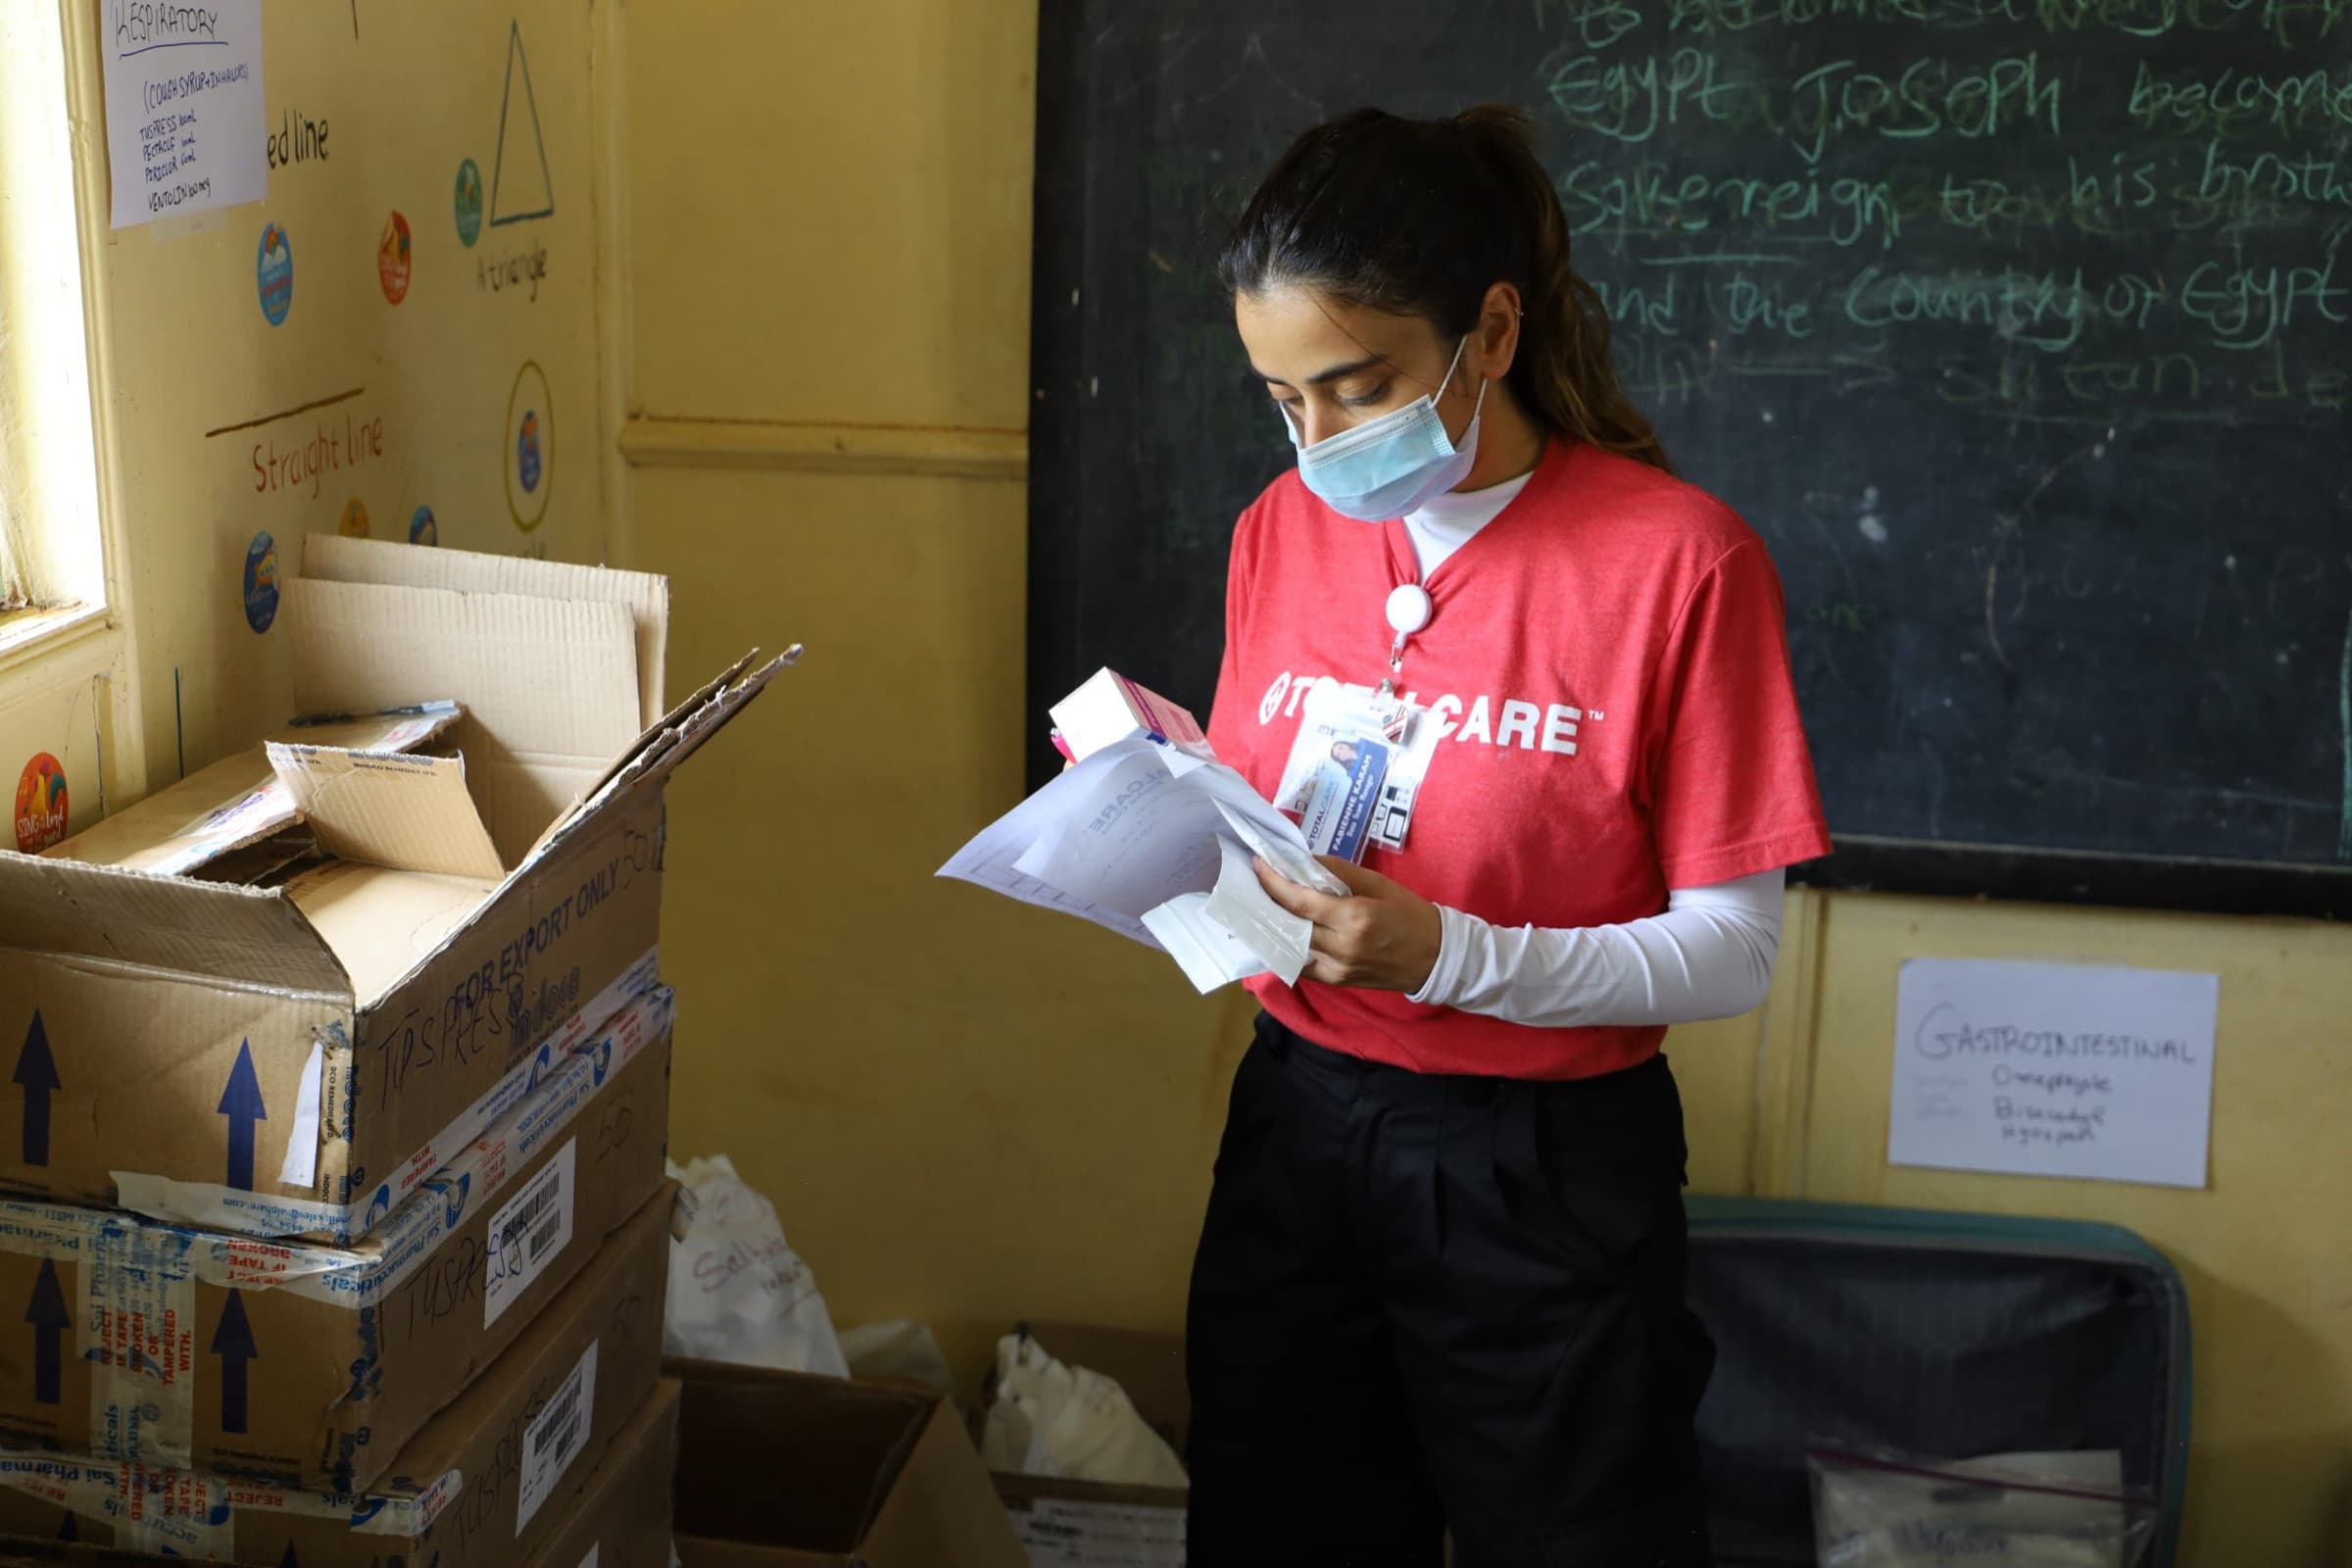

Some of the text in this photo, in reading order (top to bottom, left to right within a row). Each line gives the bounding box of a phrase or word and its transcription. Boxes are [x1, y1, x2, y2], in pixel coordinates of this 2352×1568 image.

[293, 109, 329, 164] line
[252, 415, 384, 501] Straight line
[17, 813, 39, 840] SING
[1331, 754, 1373, 853] FABIENNE KARAM
[453, 855, 620, 1021] FOR EXPORT ONLY
[1913, 1000, 2197, 1063] GASTROINTESTINAL
[101, 1308, 113, 1365] REJECT
[116, 1312, 128, 1349] TAPE
[131, 1311, 144, 1373] BROKEN
[148, 1333, 160, 1356] OR
[162, 1308, 176, 1388] TAMPERED
[179, 1329, 192, 1372] WITH.
[86, 1466, 116, 1486] Sai
[226, 1490, 284, 1507] REJECT
